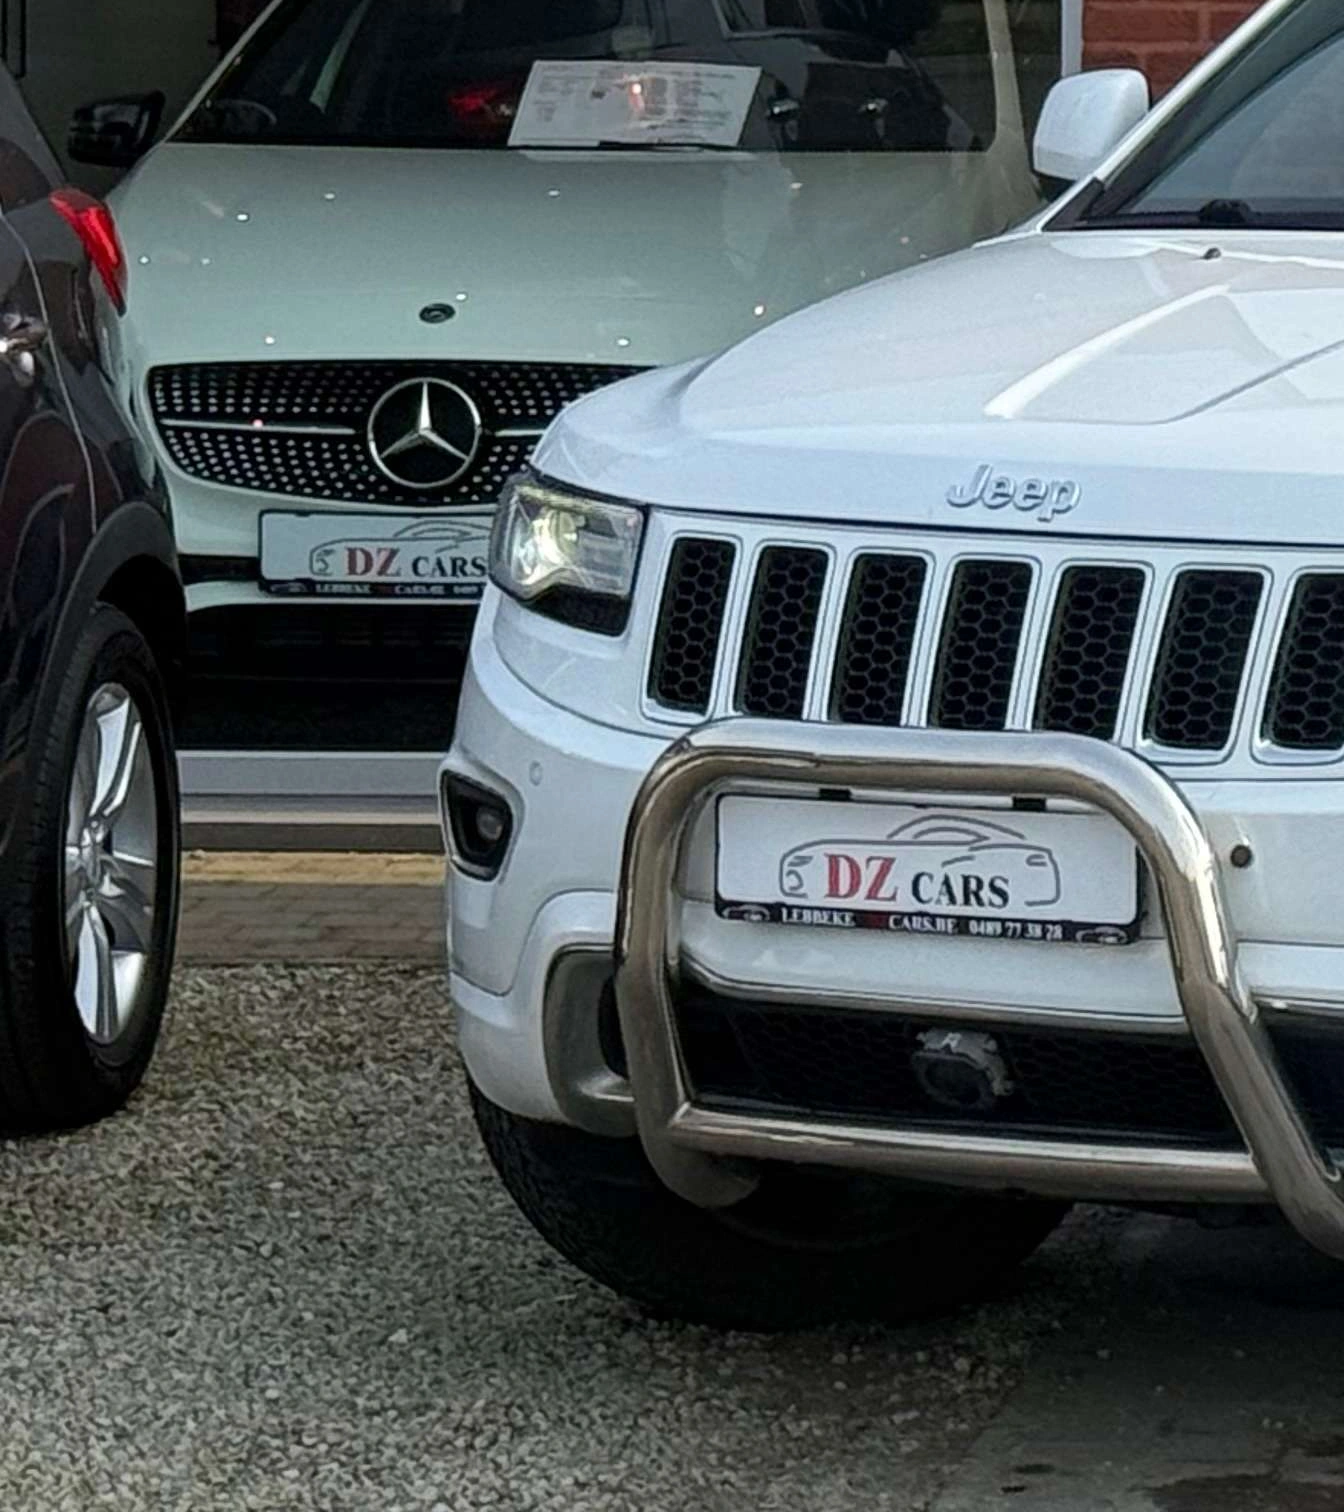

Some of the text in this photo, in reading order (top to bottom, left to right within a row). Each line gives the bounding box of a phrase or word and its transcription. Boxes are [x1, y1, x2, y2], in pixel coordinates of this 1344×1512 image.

[946, 463, 1082, 523] Jeep
[345, 547, 488, 578] DZ CARS
[822, 852, 1010, 908] DZ CARS
